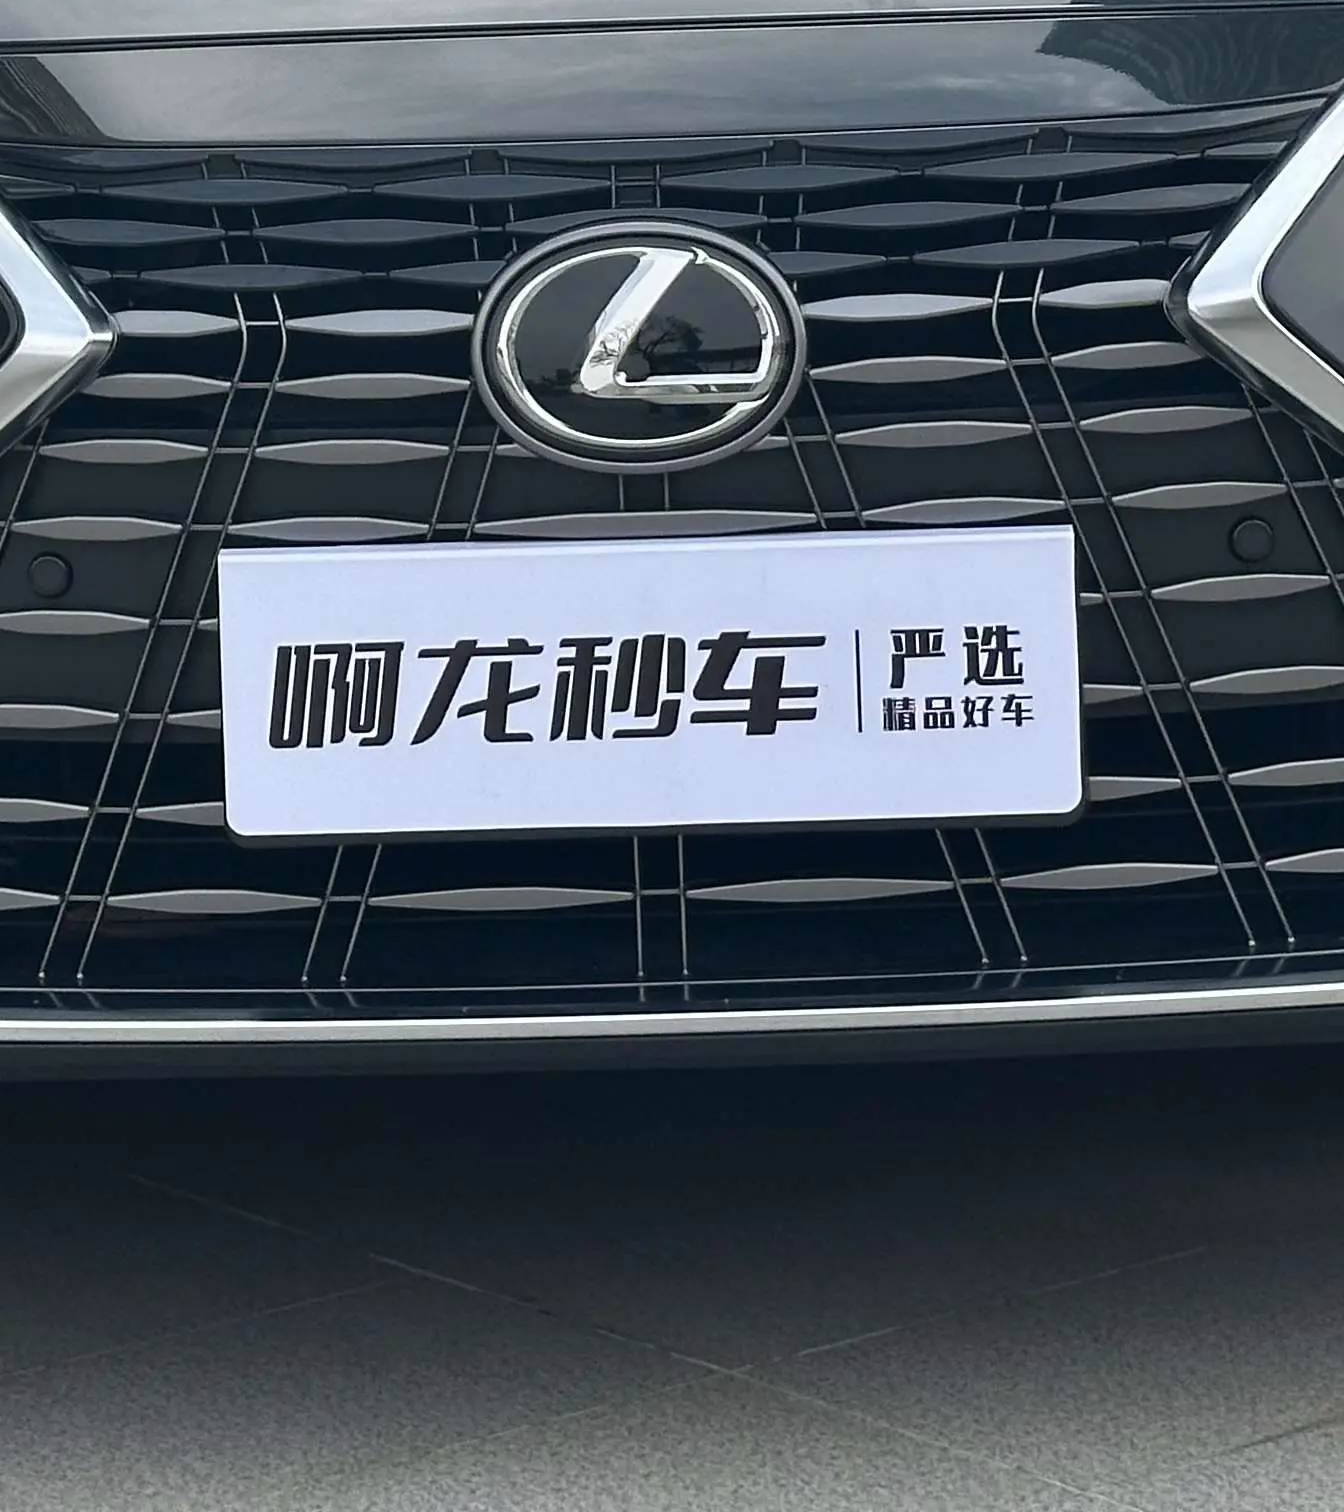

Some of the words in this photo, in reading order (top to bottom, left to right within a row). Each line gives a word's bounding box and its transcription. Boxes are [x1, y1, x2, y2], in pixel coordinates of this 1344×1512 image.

[889, 624, 1024, 689] 严选
[268, 631, 827, 750] 啊龙秒车
[882, 694, 1035, 731] 精品好车
